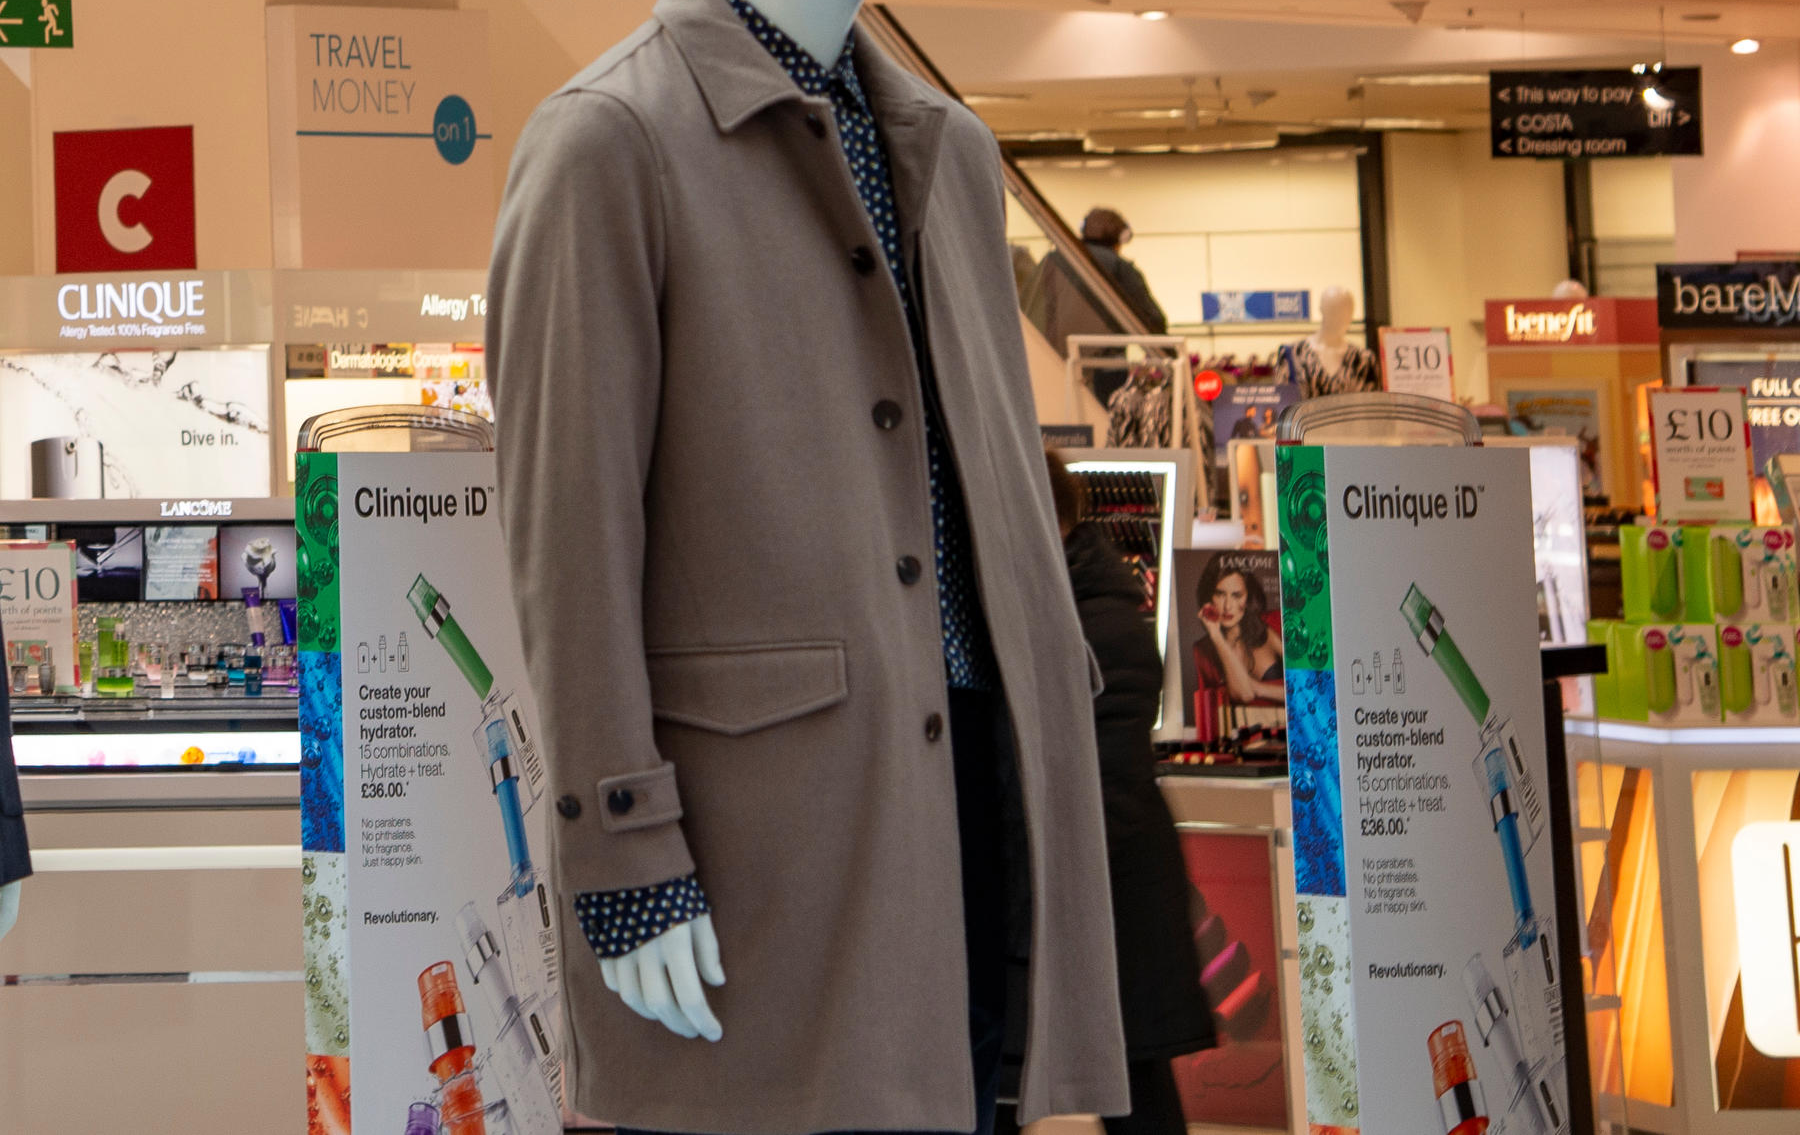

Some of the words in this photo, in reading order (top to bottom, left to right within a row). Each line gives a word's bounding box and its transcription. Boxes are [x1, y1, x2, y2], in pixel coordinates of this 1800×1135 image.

[309, 34, 412, 69] TRAVEL
[312, 78, 417, 114] MONEY
[1516, 86, 1543, 103] This
[1547, 89, 1580, 105] way
[1583, 85, 1599, 103] to
[1601, 88, 1634, 105] pay
[1516, 114, 1573, 133] COSTA
[1516, 137, 1583, 157] Dressing
[1584, 138, 1627, 154] room
[98, 169, 153, 253] C
[57, 280, 205, 324] CLINIQUE
[421, 295, 468, 320] Allergy
[1505, 303, 1598, 341] benefit
[59, 325, 88, 340] Allergy
[331, 350, 411, 372] Dermatological
[1394, 345, 1441, 370] £10
[1664, 408, 1733, 441] £10
[181, 430, 215, 446] Dive
[220, 429, 238, 446] in.
[355, 487, 457, 524] Clinique
[1343, 484, 1448, 526] Clinique
[359, 685, 402, 701] Create
[404, 685, 431, 704] your
[359, 703, 446, 720] custom-blend
[1354, 708, 1399, 726] Create
[1400, 708, 1428, 728] your
[360, 724, 417, 742] hydrator.
[1356, 729, 1444, 747] custom-blend
[359, 745, 372, 760] 15
[373, 743, 450, 759] combinations.
[1357, 753, 1415, 771] hydrator.
[360, 763, 406, 782] Hydrate
[417, 762, 445, 777] treat.
[1357, 775, 1370, 792] 15
[1371, 773, 1451, 791] combinations.
[1359, 796, 1406, 817] Hydrate
[1417, 795, 1446, 813] treat.
[362, 818, 374, 829] No
[375, 817, 412, 830] parabens.
[362, 831, 374, 841] No
[362, 844, 375, 854] No
[362, 856, 379, 867] Just
[379, 855, 404, 867] happy
[1362, 858, 1375, 869] No
[1376, 857, 1415, 871] parabens.
[1363, 873, 1376, 884] No
[1364, 887, 1377, 899] No
[364, 909, 439, 925] Revolutionary.
[1365, 902, 1382, 914] Just
[1383, 901, 1408, 915] happy
[1369, 963, 1447, 979] Revolutionary.
